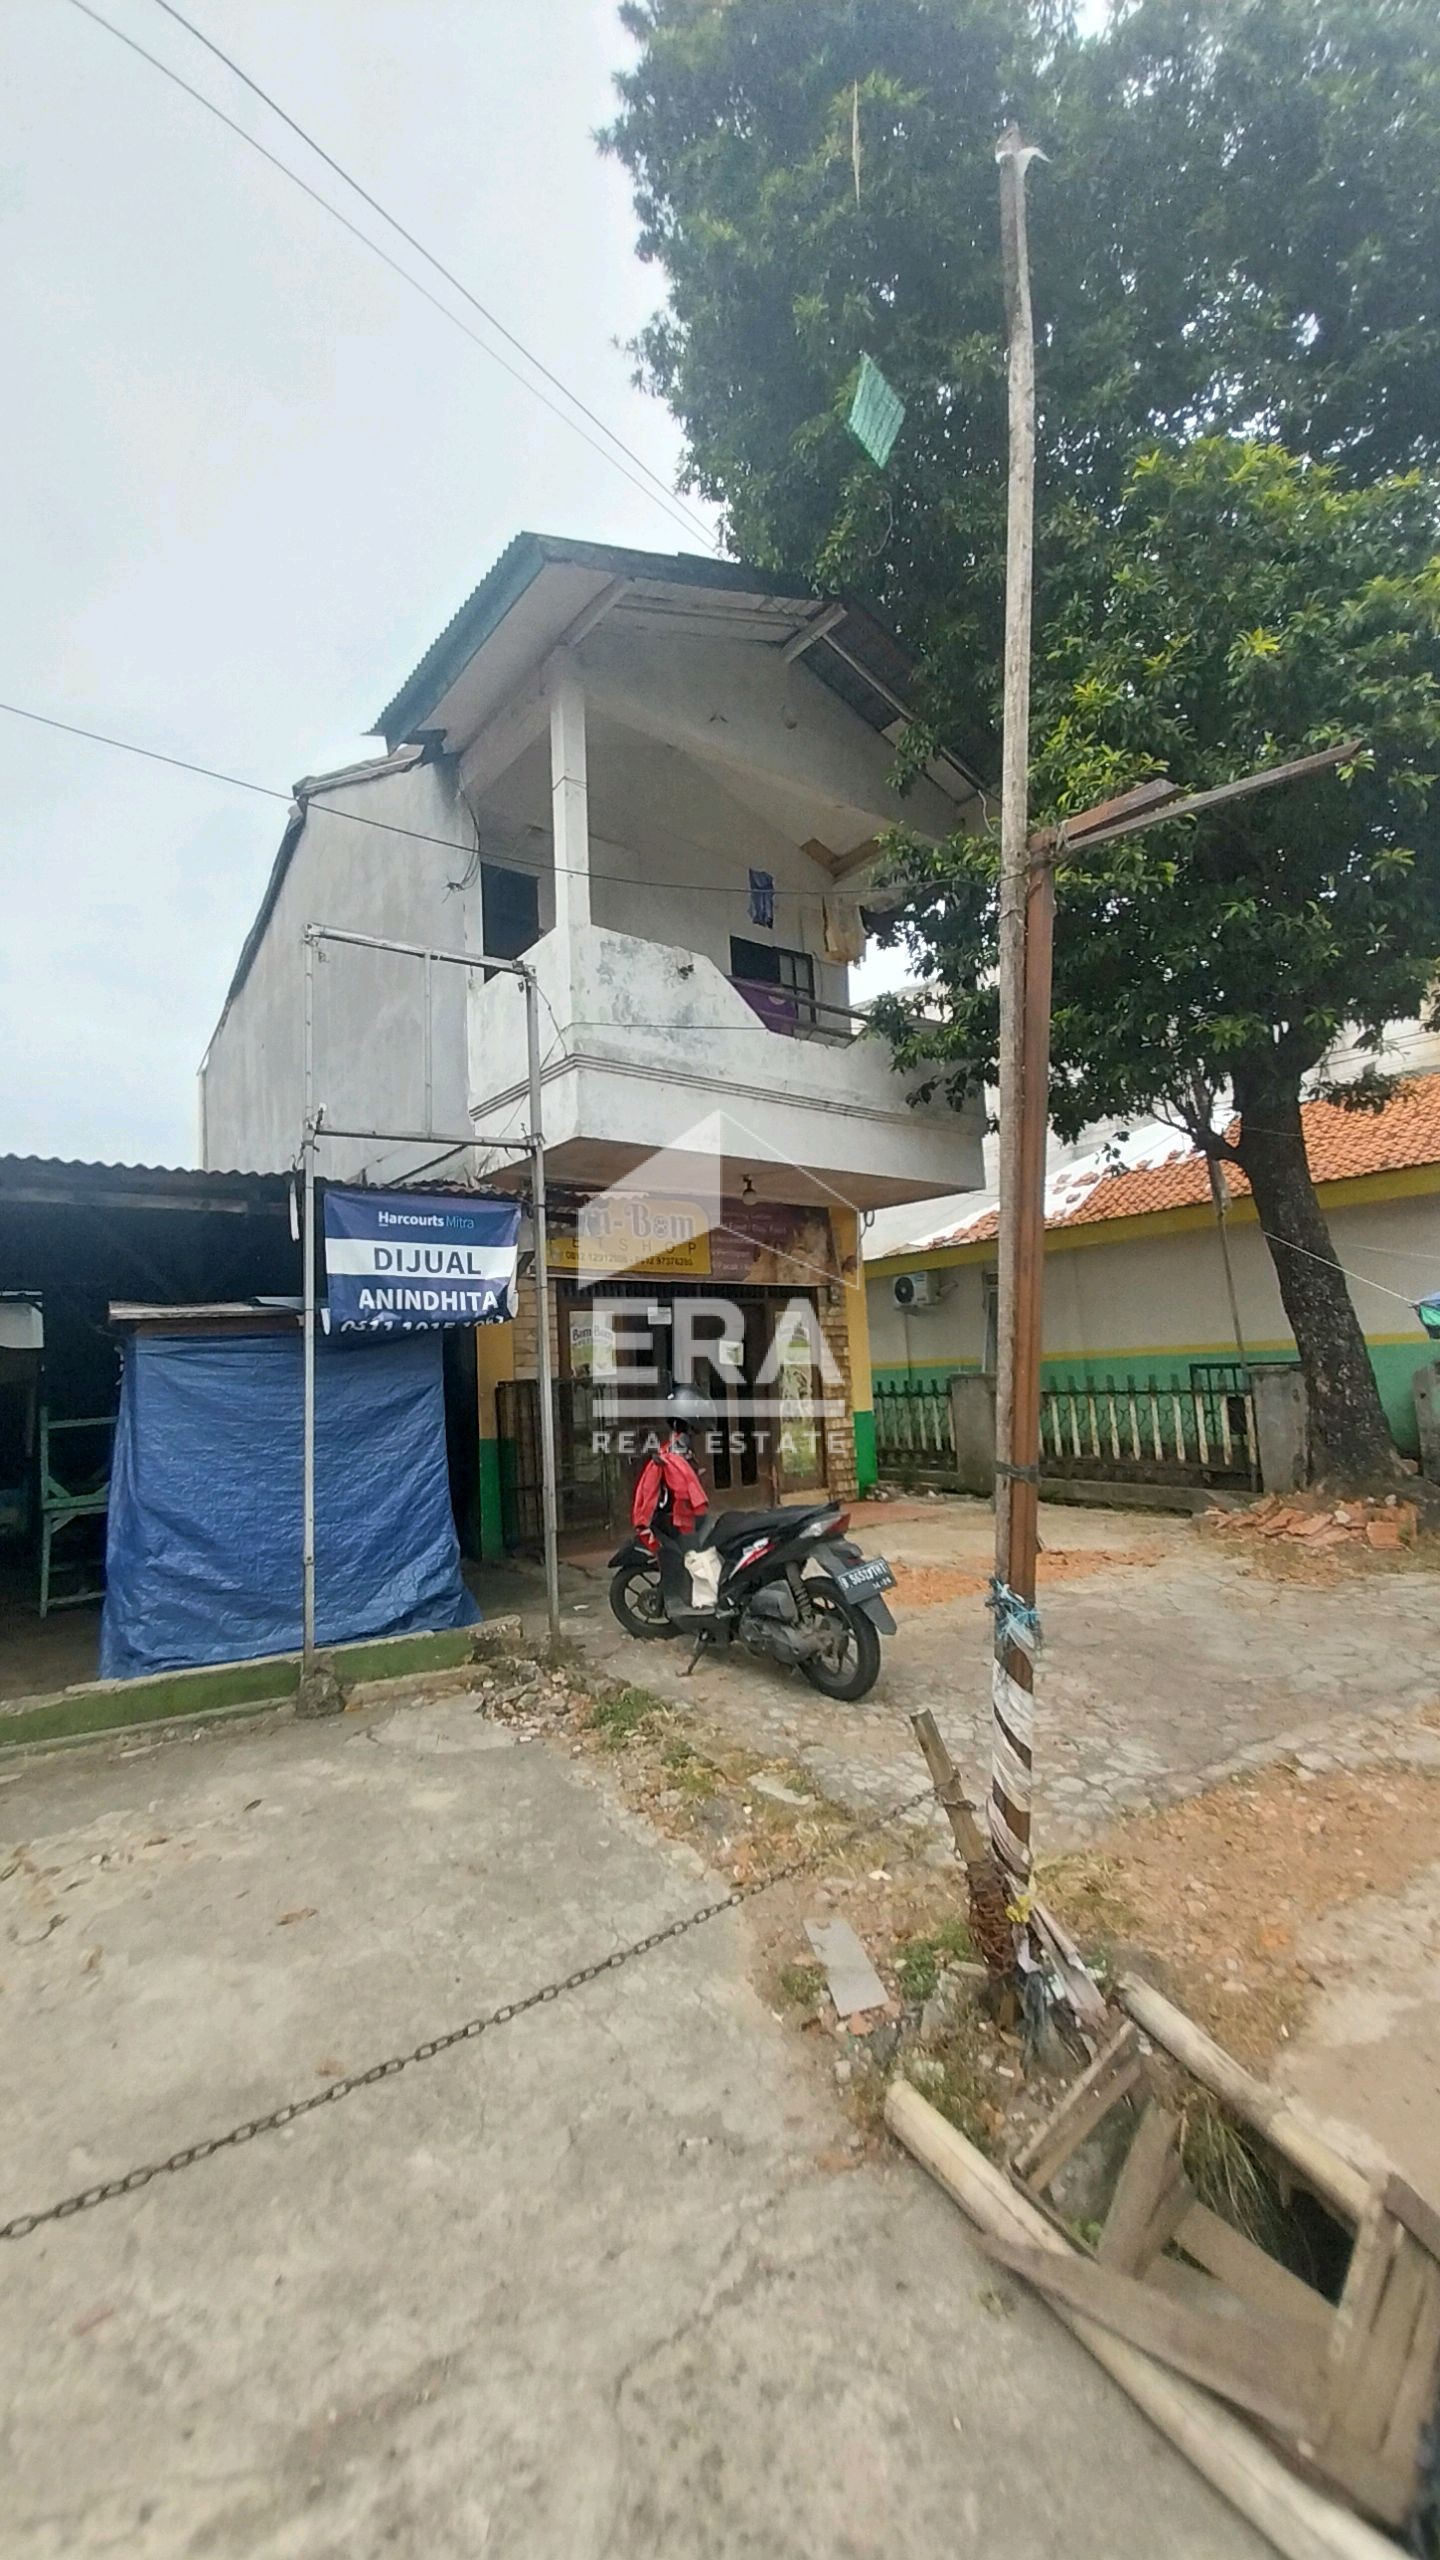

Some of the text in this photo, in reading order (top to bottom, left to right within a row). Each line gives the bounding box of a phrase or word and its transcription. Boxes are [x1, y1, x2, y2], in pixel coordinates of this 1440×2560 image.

[378, 1211, 475, 1229] Harcourts Mitra
[374, 1247, 482, 1275] DIJUAL
[359, 1289, 499, 1311] ANINDHITA
